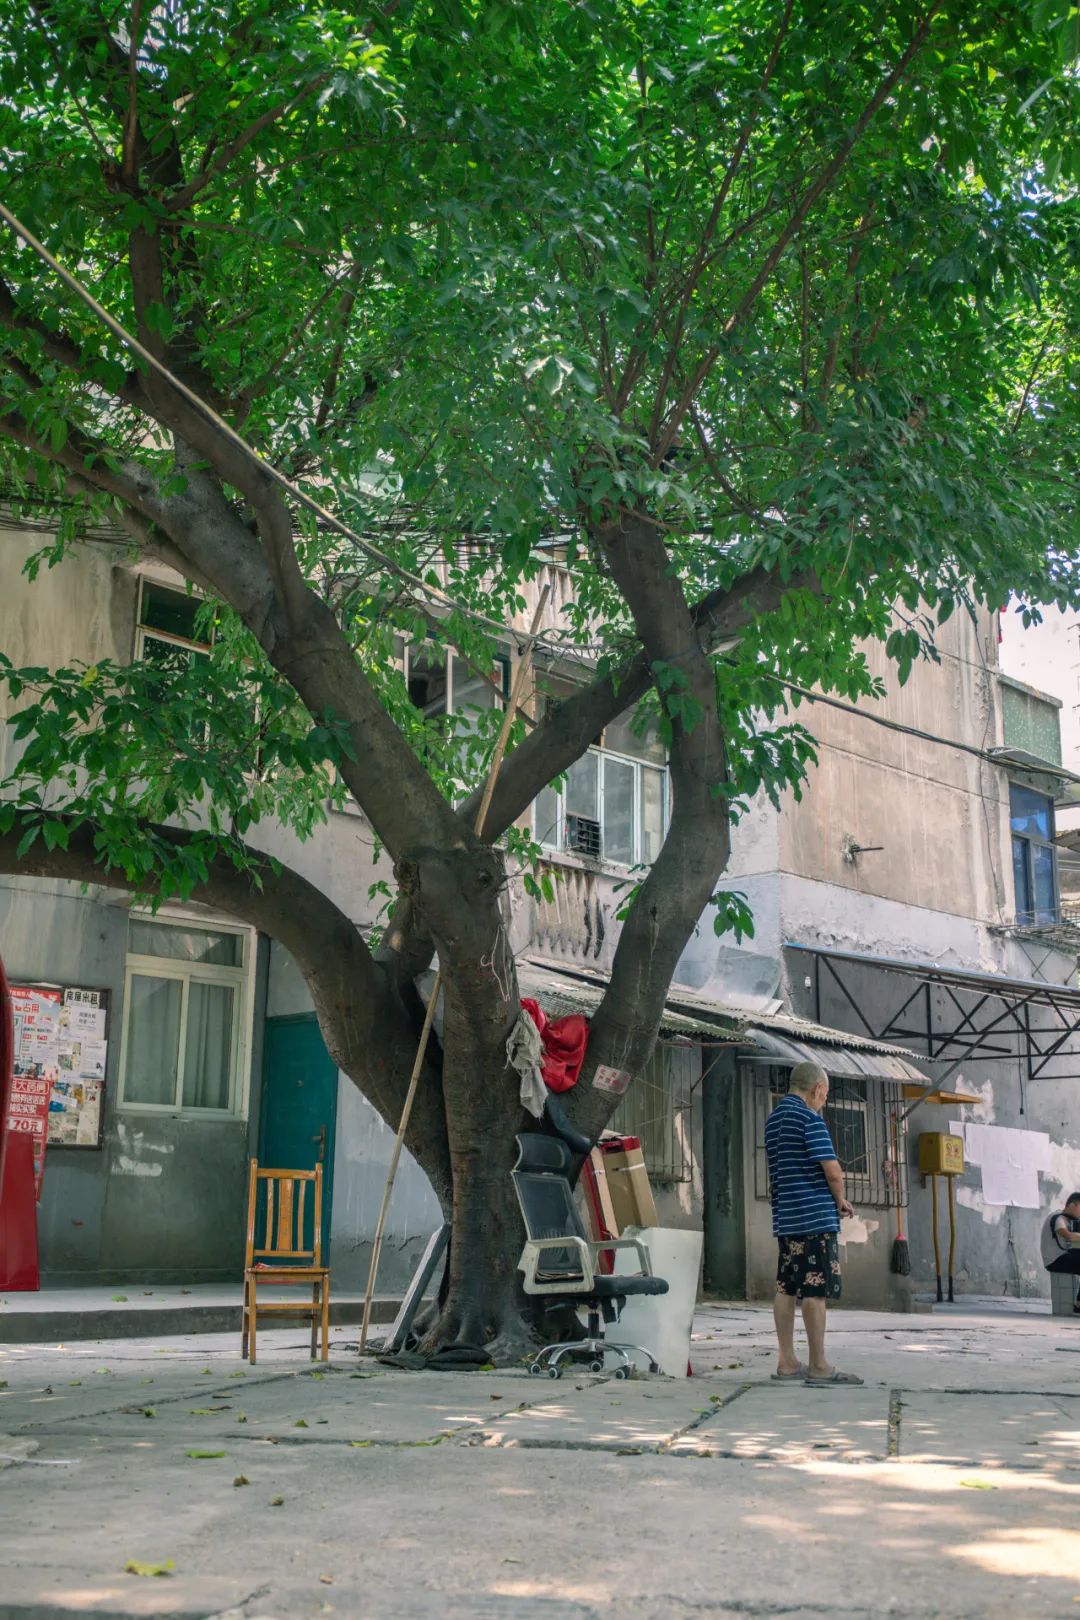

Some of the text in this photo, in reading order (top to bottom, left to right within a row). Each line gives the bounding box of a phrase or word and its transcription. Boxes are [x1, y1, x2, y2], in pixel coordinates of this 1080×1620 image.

[66, 991, 98, 1004] 房屋出租
[13, 1119, 38, 1132] 70元
